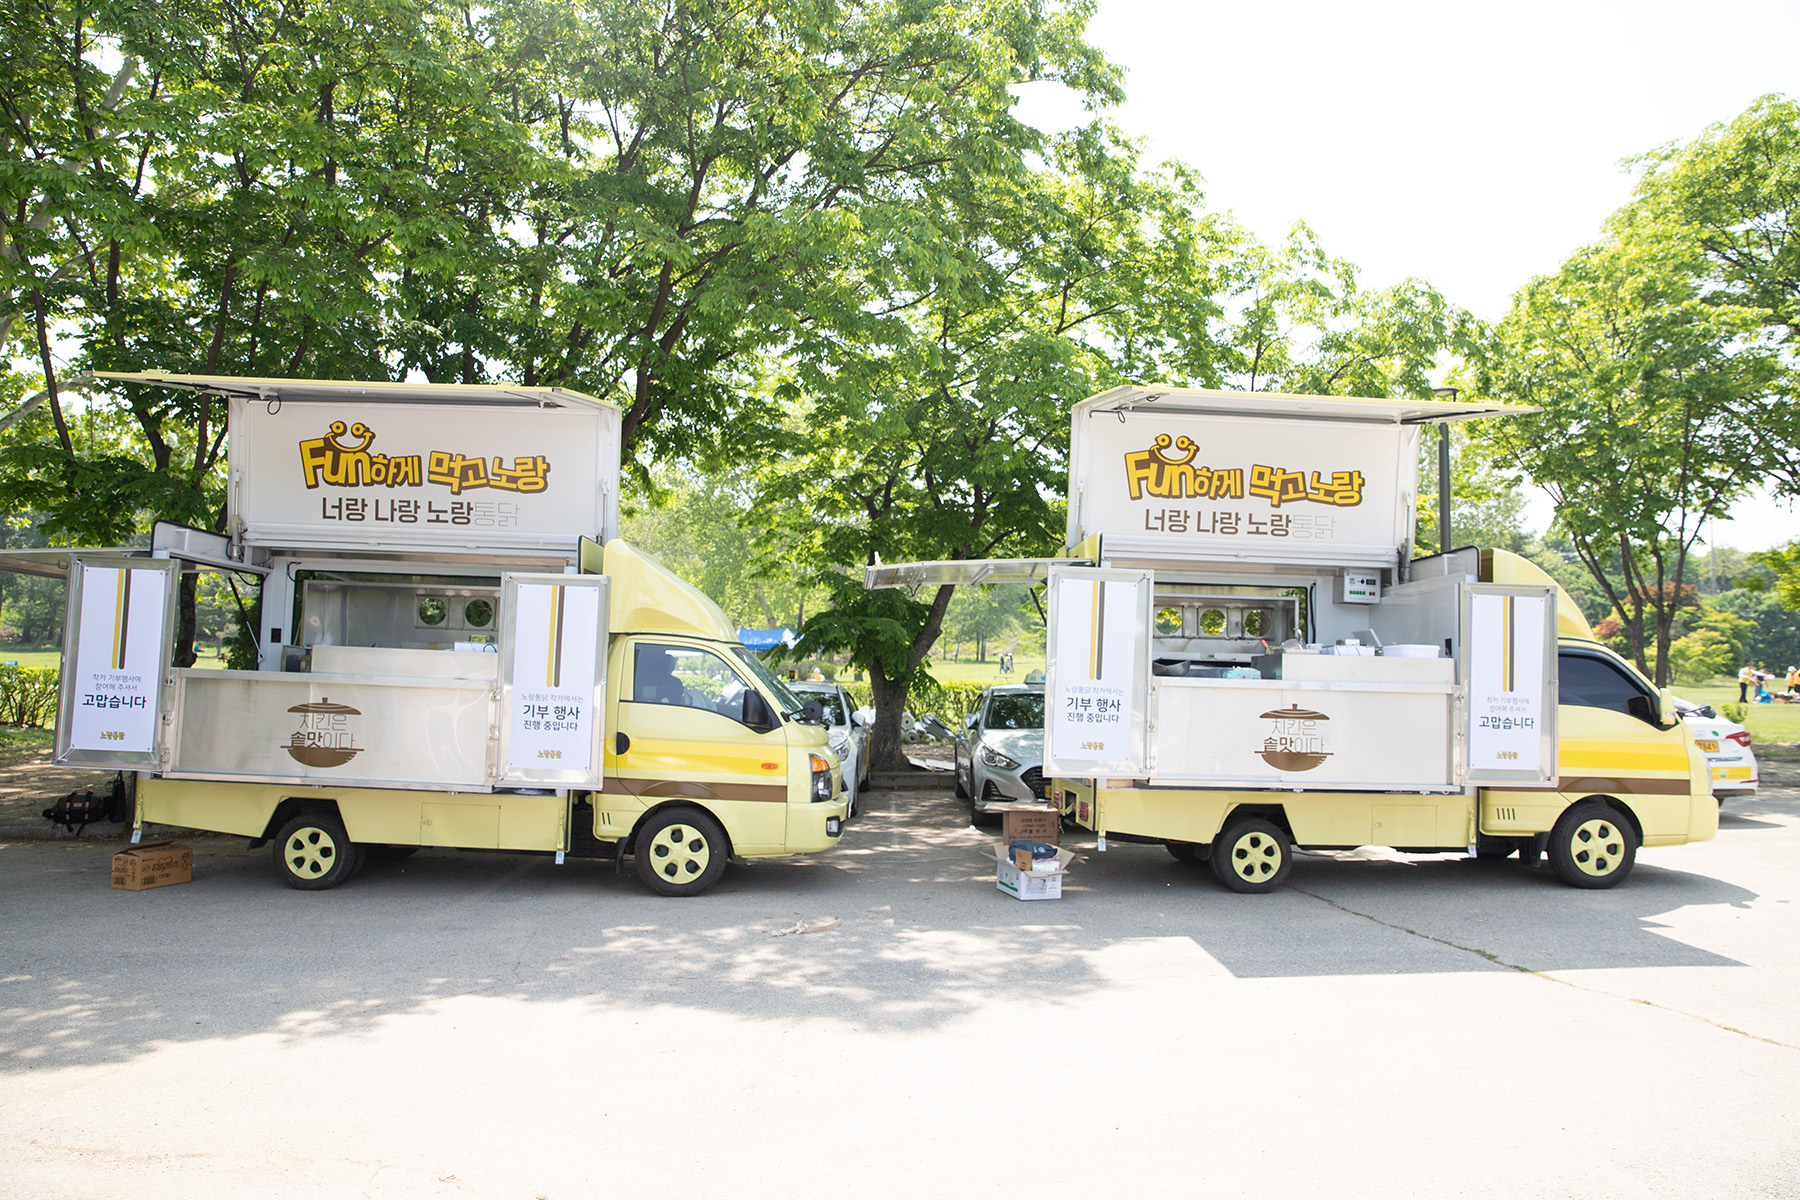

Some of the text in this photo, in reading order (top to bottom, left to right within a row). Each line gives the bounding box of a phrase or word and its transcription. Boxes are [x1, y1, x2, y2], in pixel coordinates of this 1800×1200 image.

[299, 438, 423, 489] Fun하게
[1124, 450, 1244, 500] Fun하게
[322, 497, 520, 527] 너랑 나랑 노랑통닭
[1145, 509, 1336, 539] 너랑 나랑 노랑통닭
[82, 694, 147, 709] 고맙습니다
[1067, 697, 1121, 712] 기부 행사
[523, 704, 580, 720] 기부 행사
[1067, 712, 1119, 723] 진행 중입니다
[299, 713, 347, 731] 치킨은
[523, 720, 578, 731] 진행 중입니다
[1272, 718, 1316, 736] 치킨은
[1479, 716, 1535, 730] 고맙습니다
